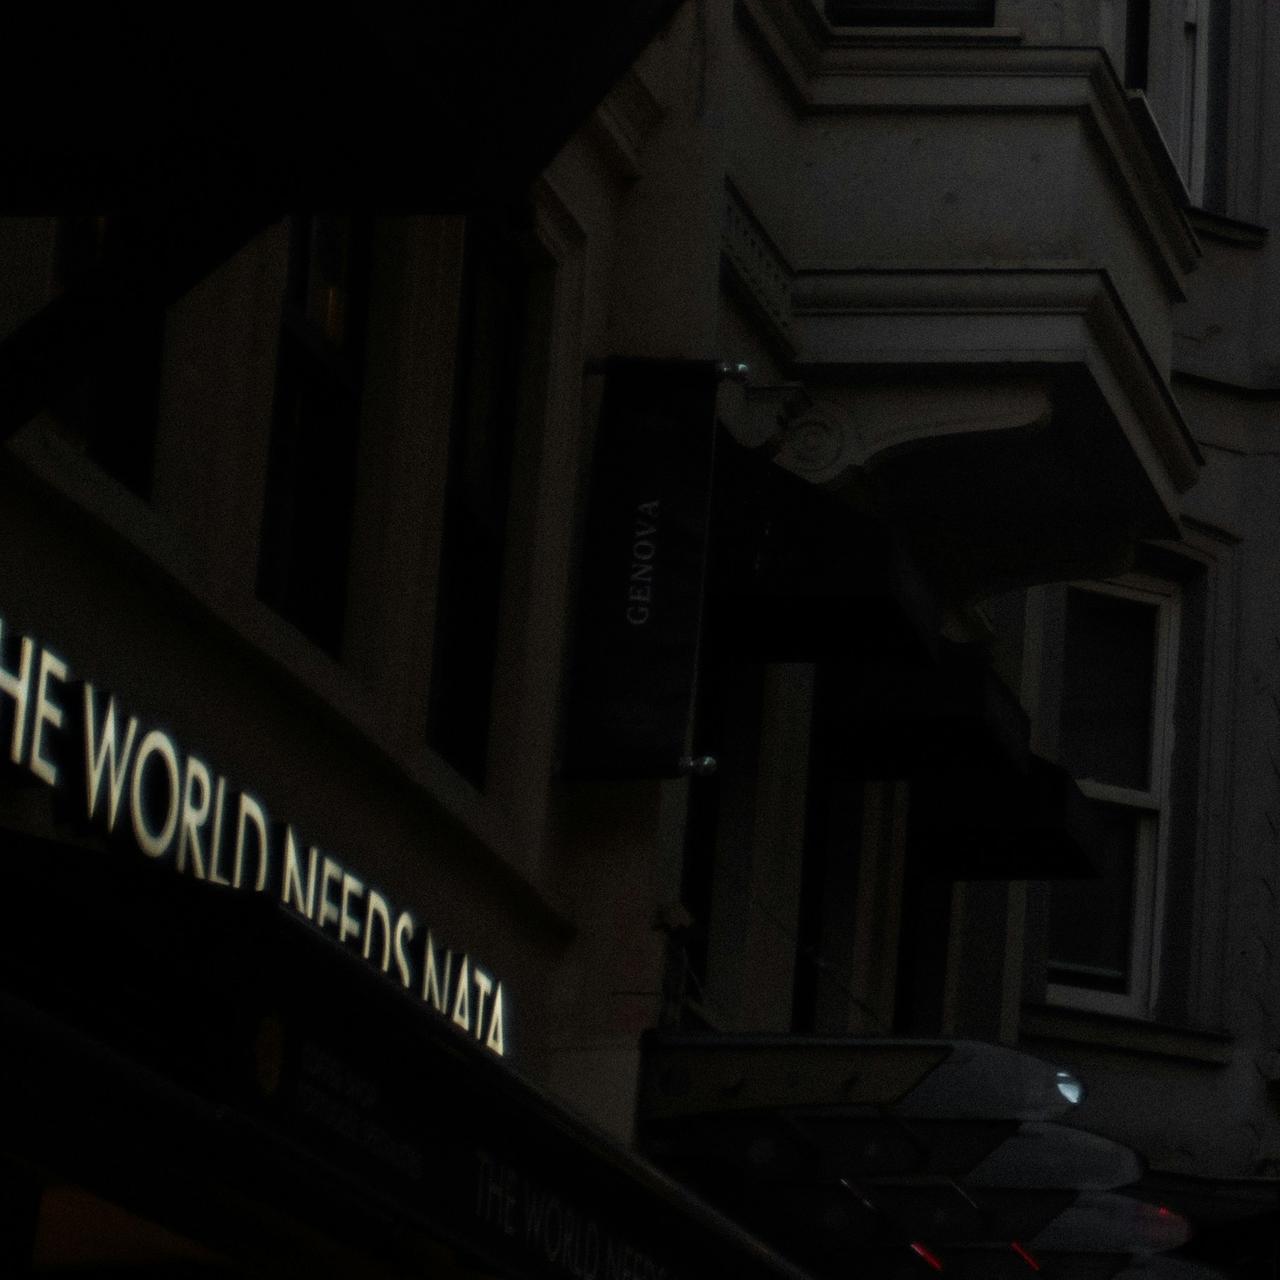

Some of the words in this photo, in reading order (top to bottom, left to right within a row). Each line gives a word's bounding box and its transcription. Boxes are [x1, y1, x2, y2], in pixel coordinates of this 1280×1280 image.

[626, 499, 660, 626] GENOVA
[0, 615, 68, 787] HE
[84, 681, 268, 892] WORLD
[422, 927, 505, 1058] NATA
[475, 1148, 520, 1236] THE
